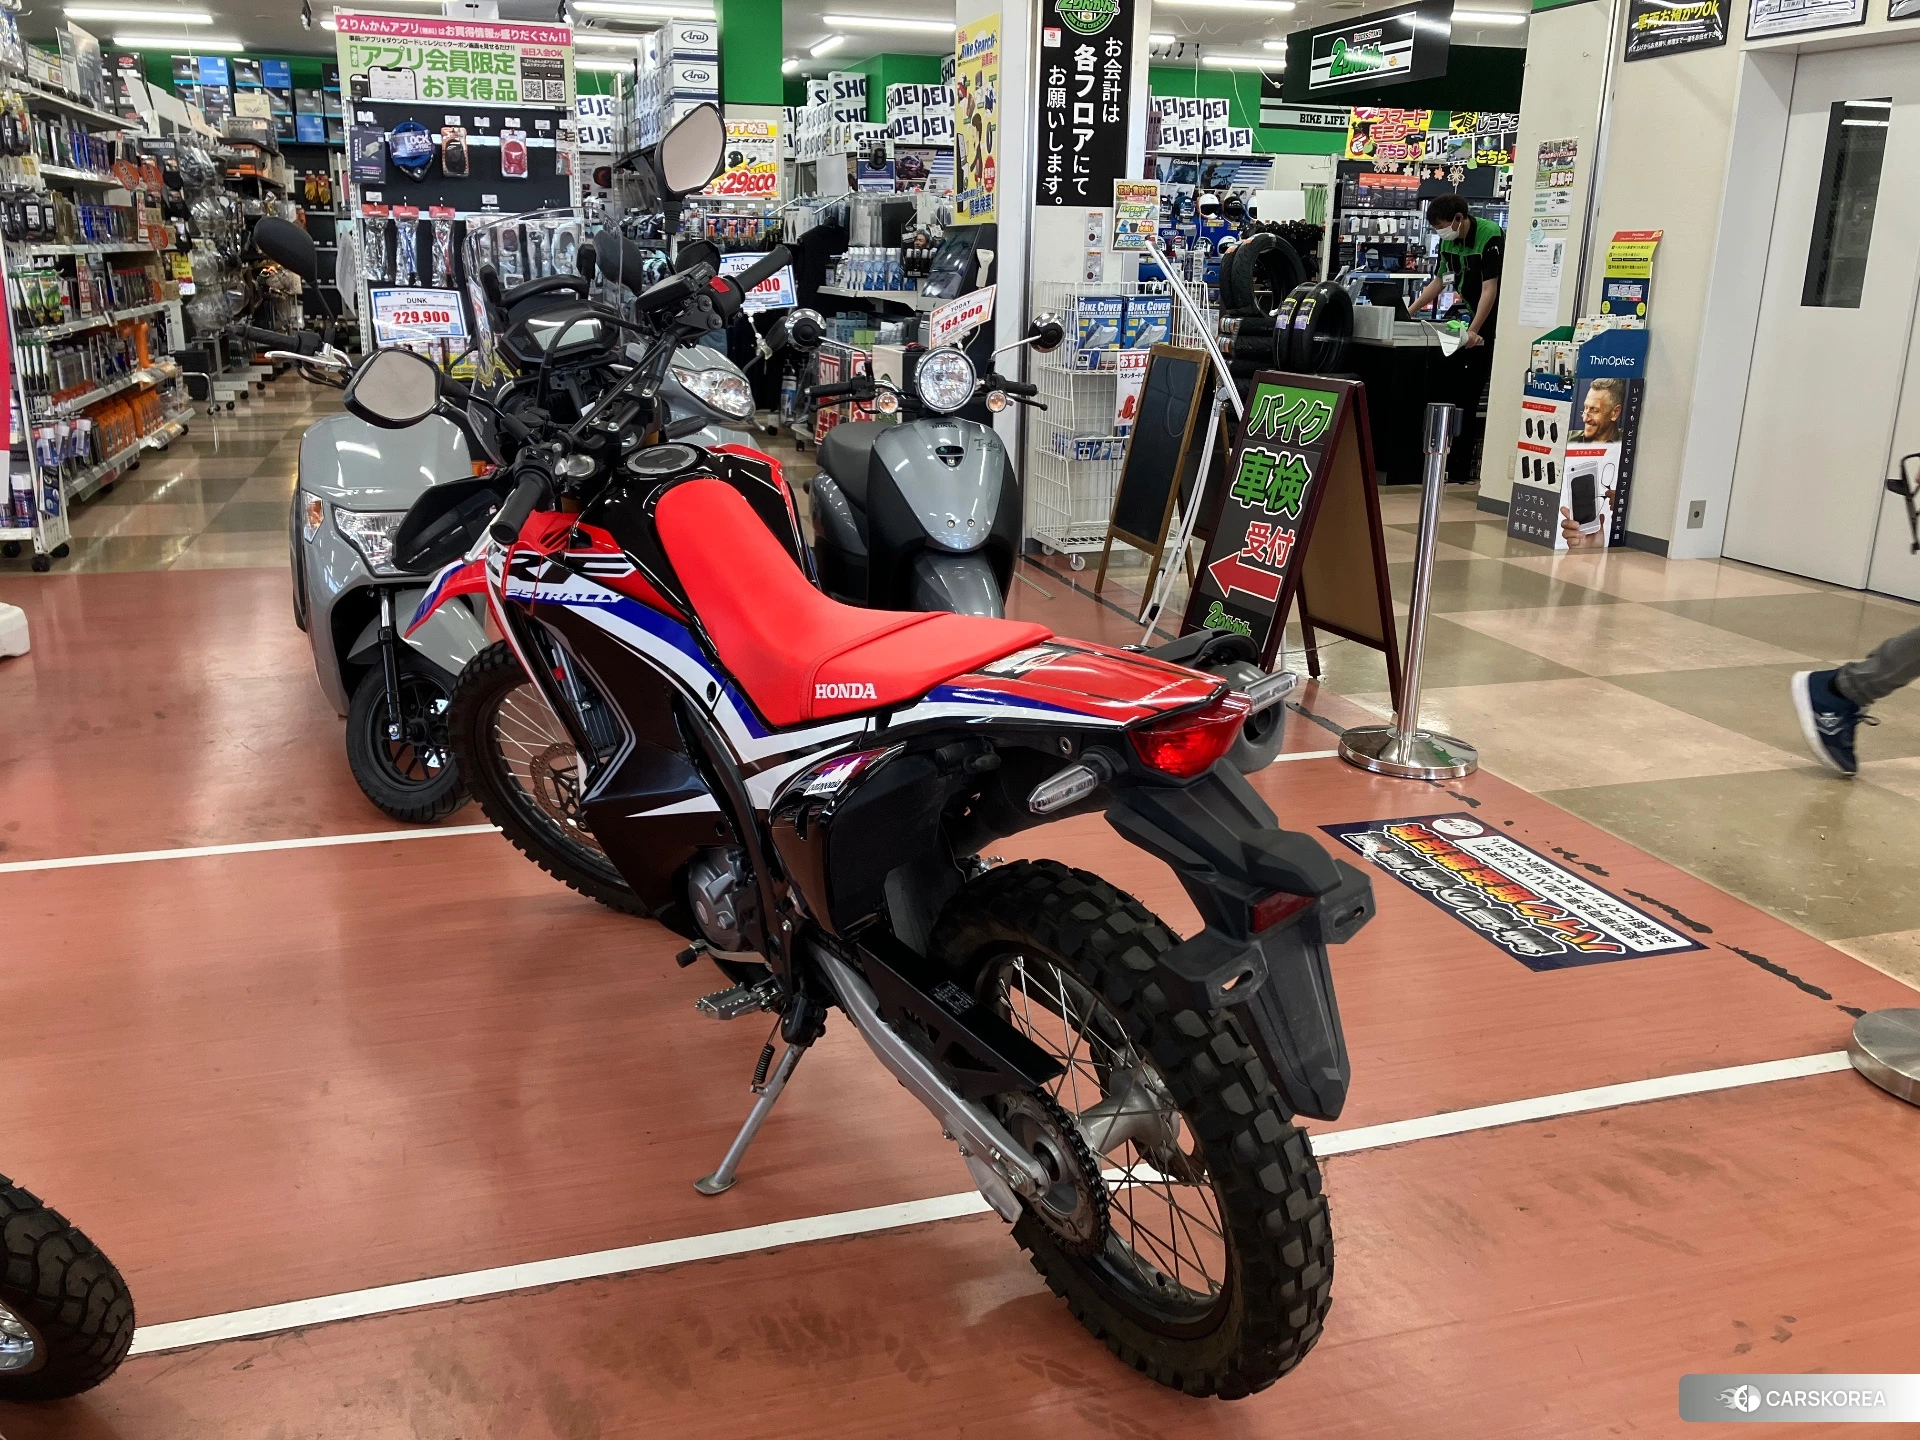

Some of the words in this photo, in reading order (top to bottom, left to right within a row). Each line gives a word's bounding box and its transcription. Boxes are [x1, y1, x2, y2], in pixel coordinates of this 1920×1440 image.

[682, 31, 707, 42] Arai
[974, 33, 995, 56] Search
[359, 45, 516, 75] アプリ会員限定
[684, 70, 709, 80] Arai
[1102, 36, 1123, 123] お会計は
[422, 75, 518, 102] お買得品
[1072, 43, 1098, 196] 各フロアにて
[1300, 114, 1322, 124] BIKE
[1324, 115, 1345, 126] LIFE
[1379, 109, 1428, 124] スマート
[726, 122, 768, 135] すすめ品
[1045, 64, 1067, 205] お願いします。
[1370, 124, 1420, 140] モニター
[404, 134, 430, 149] LOCK
[1376, 143, 1408, 158] こちら
[1476, 150, 1509, 165] こちら
[730, 263, 750, 272] TACT
[951, 300, 971, 312] TODAY
[1078, 302, 1096, 312] BIKE
[1097, 301, 1122, 312] COVER
[1128, 302, 1146, 312] BIKE
[1146, 301, 1171, 311] COVER
[393, 310, 450, 325] 229,900
[940, 305, 983, 333] 184,900
[1120, 354, 1149, 368] おすす
[1590, 356, 1635, 367] ThinOptics
[1248, 393, 1332, 445] バイク
[1230, 447, 1312, 520] 車検
[1517, 492, 1550, 507] いつでも、
[1515, 506, 1548, 523] どこでも、
[1242, 520, 1295, 568] 受付
[815, 683, 877, 699] HONDA
